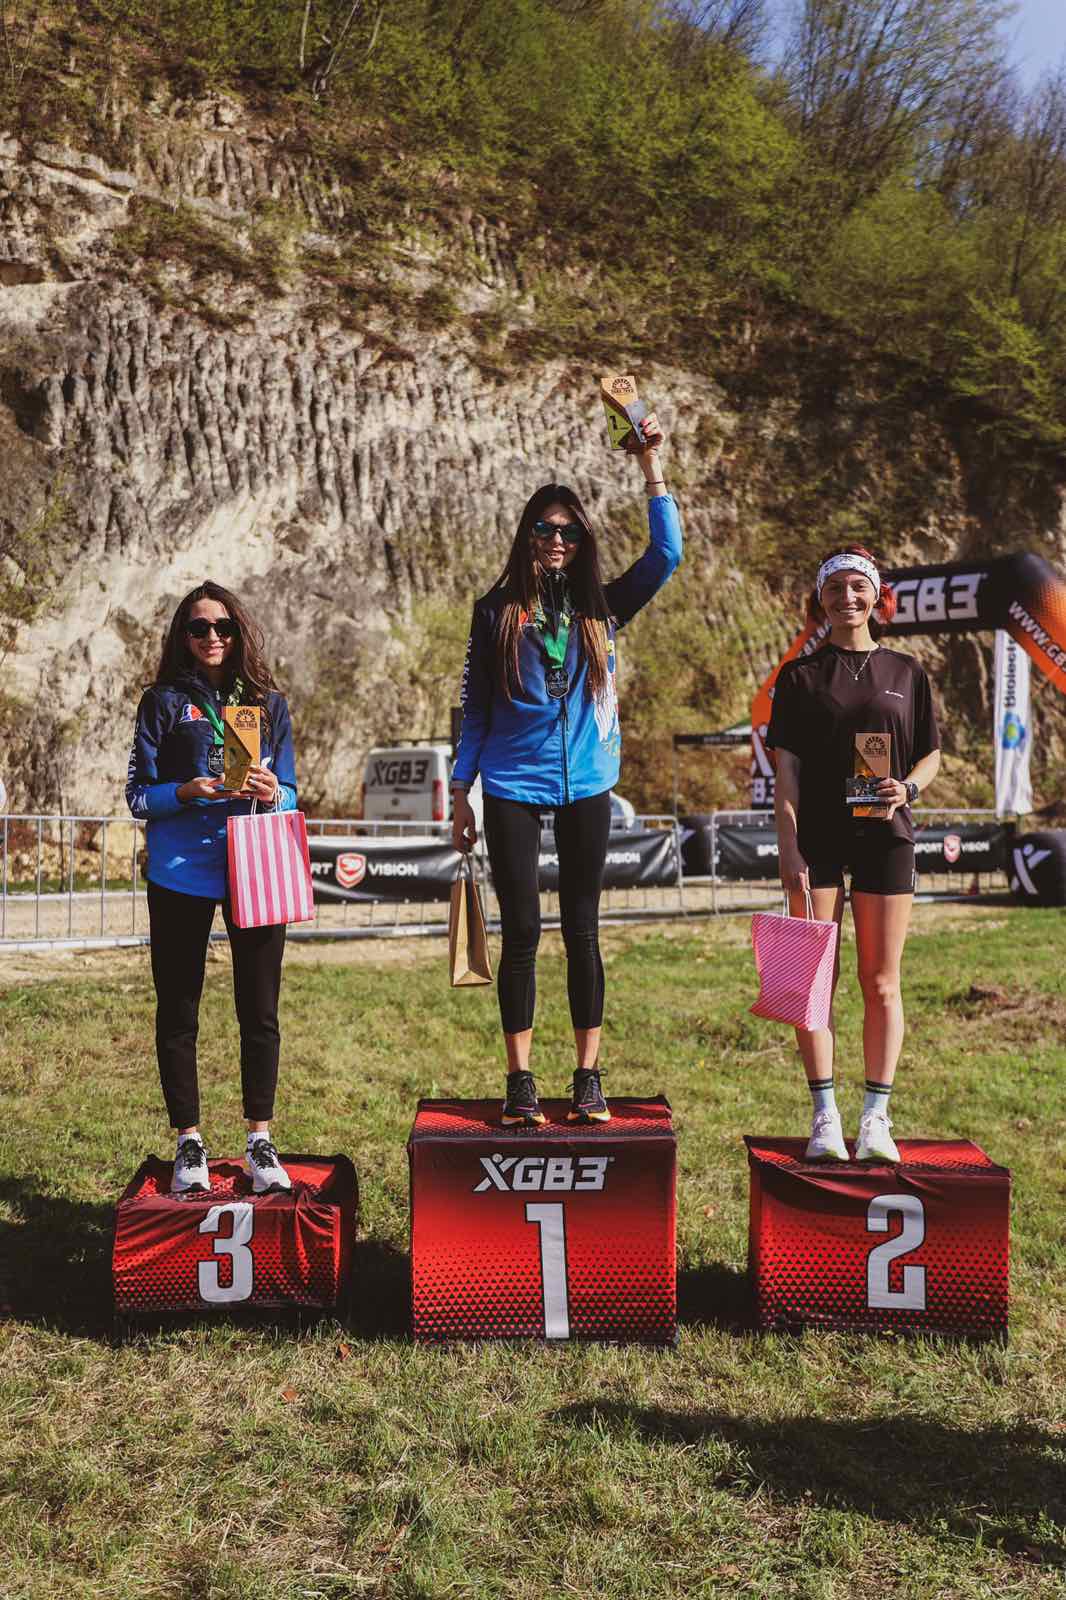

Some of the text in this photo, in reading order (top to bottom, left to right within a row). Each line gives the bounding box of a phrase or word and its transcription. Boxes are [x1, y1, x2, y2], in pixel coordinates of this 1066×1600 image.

[874, 573, 981, 624] GB3
[369, 760, 429, 786] XGB3
[962, 841, 989, 851] VISION
[368, 863, 419, 876] VISION
[473, 1153, 609, 1192] XGB3
[198, 1202, 254, 1303] 3
[525, 1202, 570, 1339] 1
[867, 1193, 927, 1310] 2
